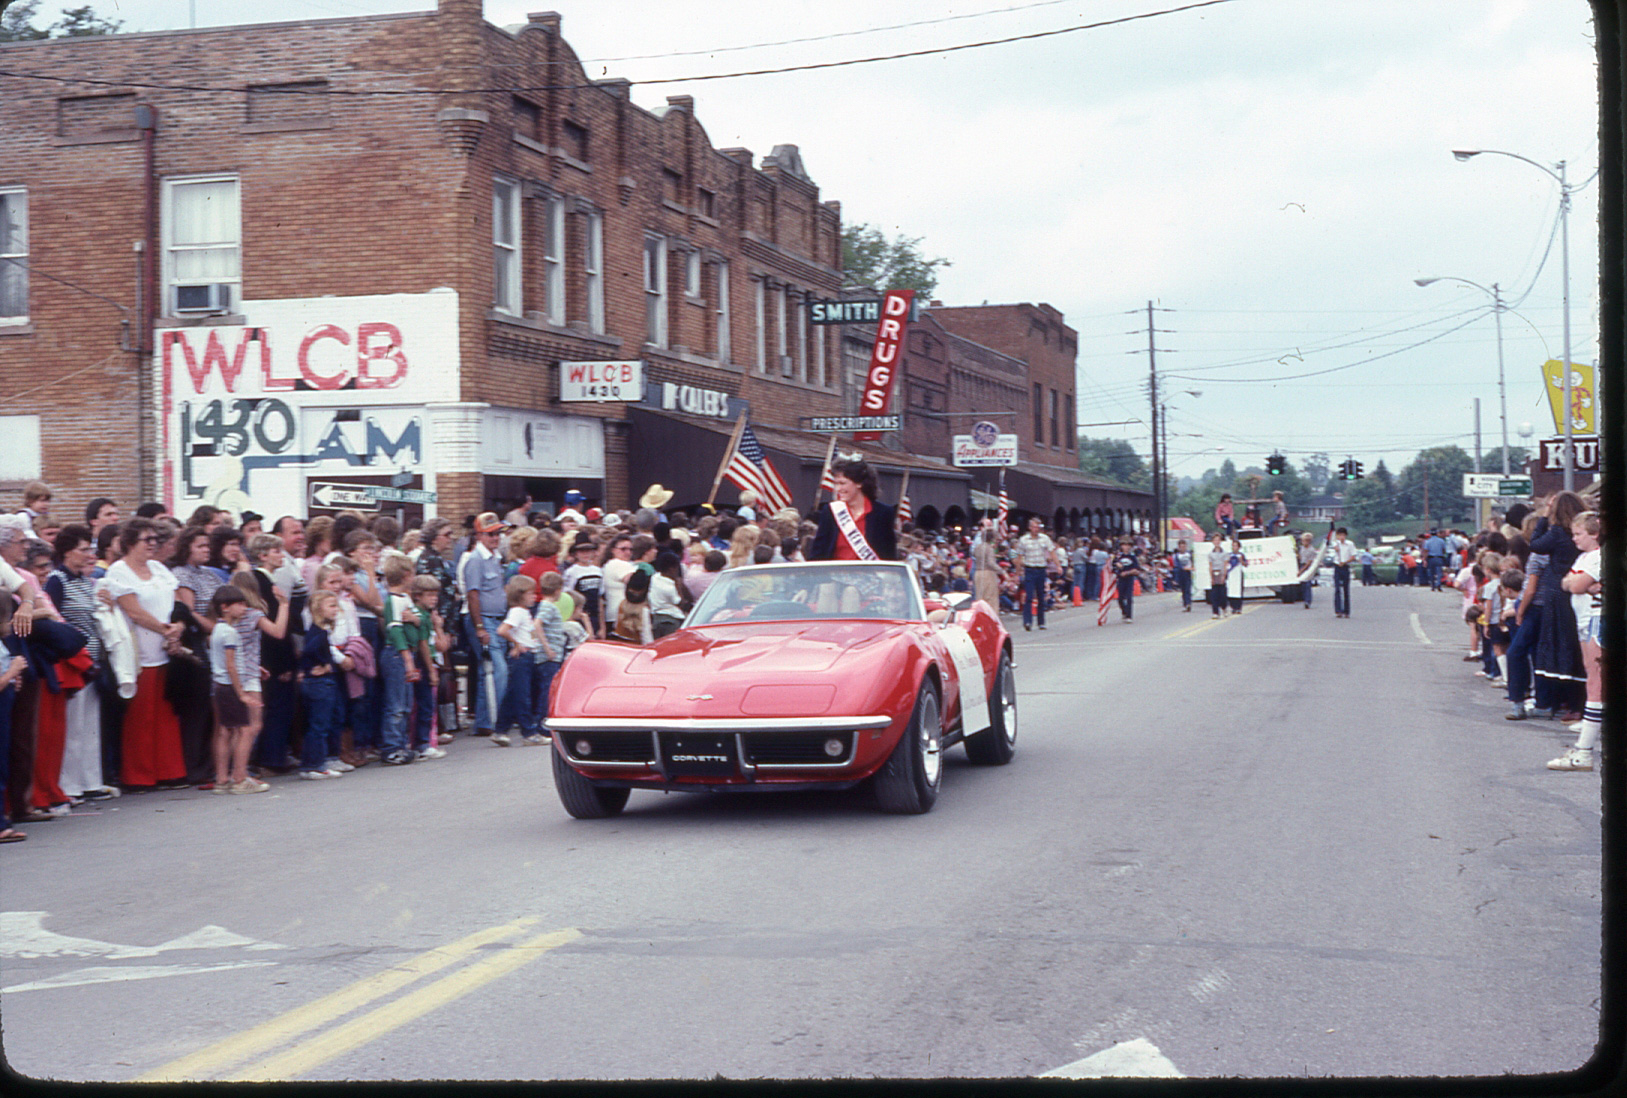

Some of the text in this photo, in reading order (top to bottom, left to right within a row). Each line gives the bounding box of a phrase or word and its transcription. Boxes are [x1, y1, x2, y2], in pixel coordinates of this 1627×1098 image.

[811, 302, 879, 321] SMITH
[864, 295, 906, 410] DRUGS
[568, 364, 633, 383] WLCB
[581, 385, 620, 398] 1430
[811, 416, 900, 430] PRESCRIPTIONS
[316, 415, 421, 467] AM
[332, 491, 351, 502] ONE
